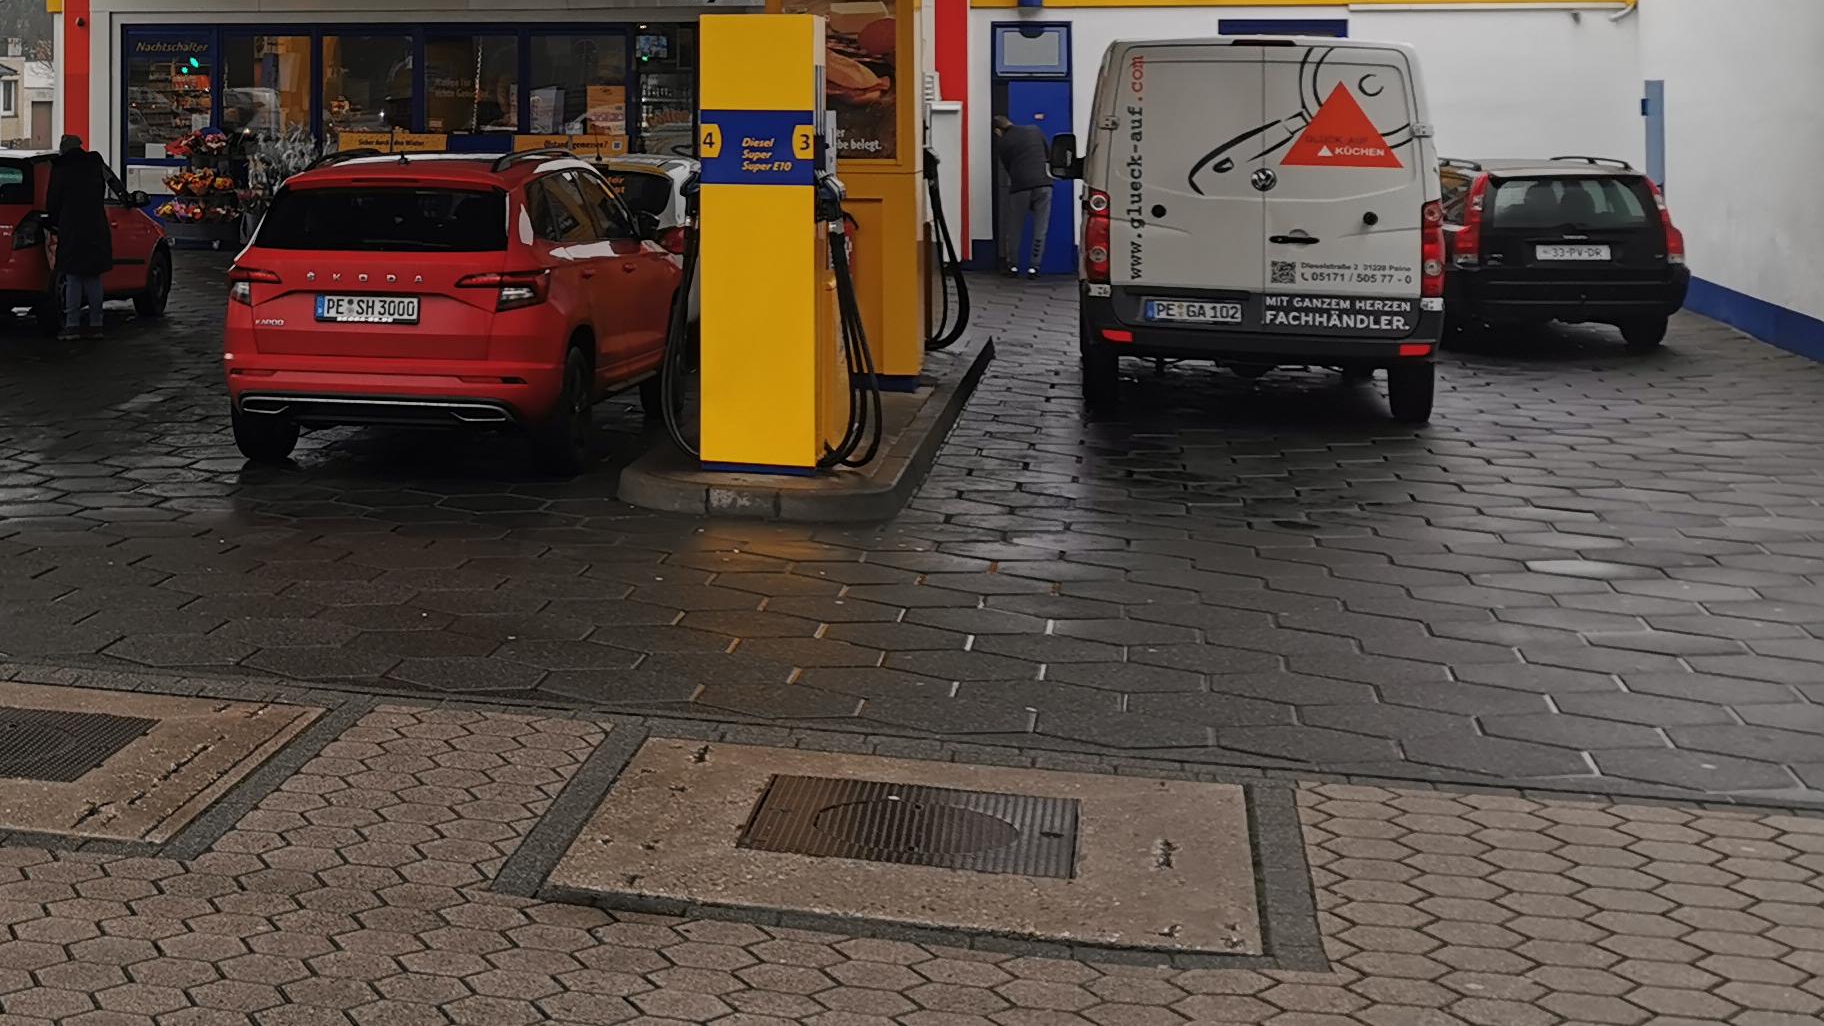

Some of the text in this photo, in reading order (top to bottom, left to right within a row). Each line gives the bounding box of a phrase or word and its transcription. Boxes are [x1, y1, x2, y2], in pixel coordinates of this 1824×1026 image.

[136, 41, 208, 52] Nachtschalter
[703, 133, 715, 148] 4
[742, 138, 774, 147] Diesel
[799, 134, 810, 150] 3
[851, 139, 882, 152] belegt.
[742, 149, 772, 160] Super
[1334, 146, 1384, 157] KÜCHEN
[742, 162, 792, 172] Super E10
[1127, 55, 1145, 280] www.glueck-auf.com
[1312, 273, 1345, 282] 05171
[1356, 274, 1377, 283] 505
[1381, 274, 1394, 283] 77
[1405, 275, 1412, 284] 0
[327, 299, 415, 317] PE SH 3000
[1157, 303, 1239, 319] PE GA 102
[1266, 297, 1411, 312] MIT GANZEM HERZEN
[1265, 311, 1410, 330] FACHHÄNDLER.
